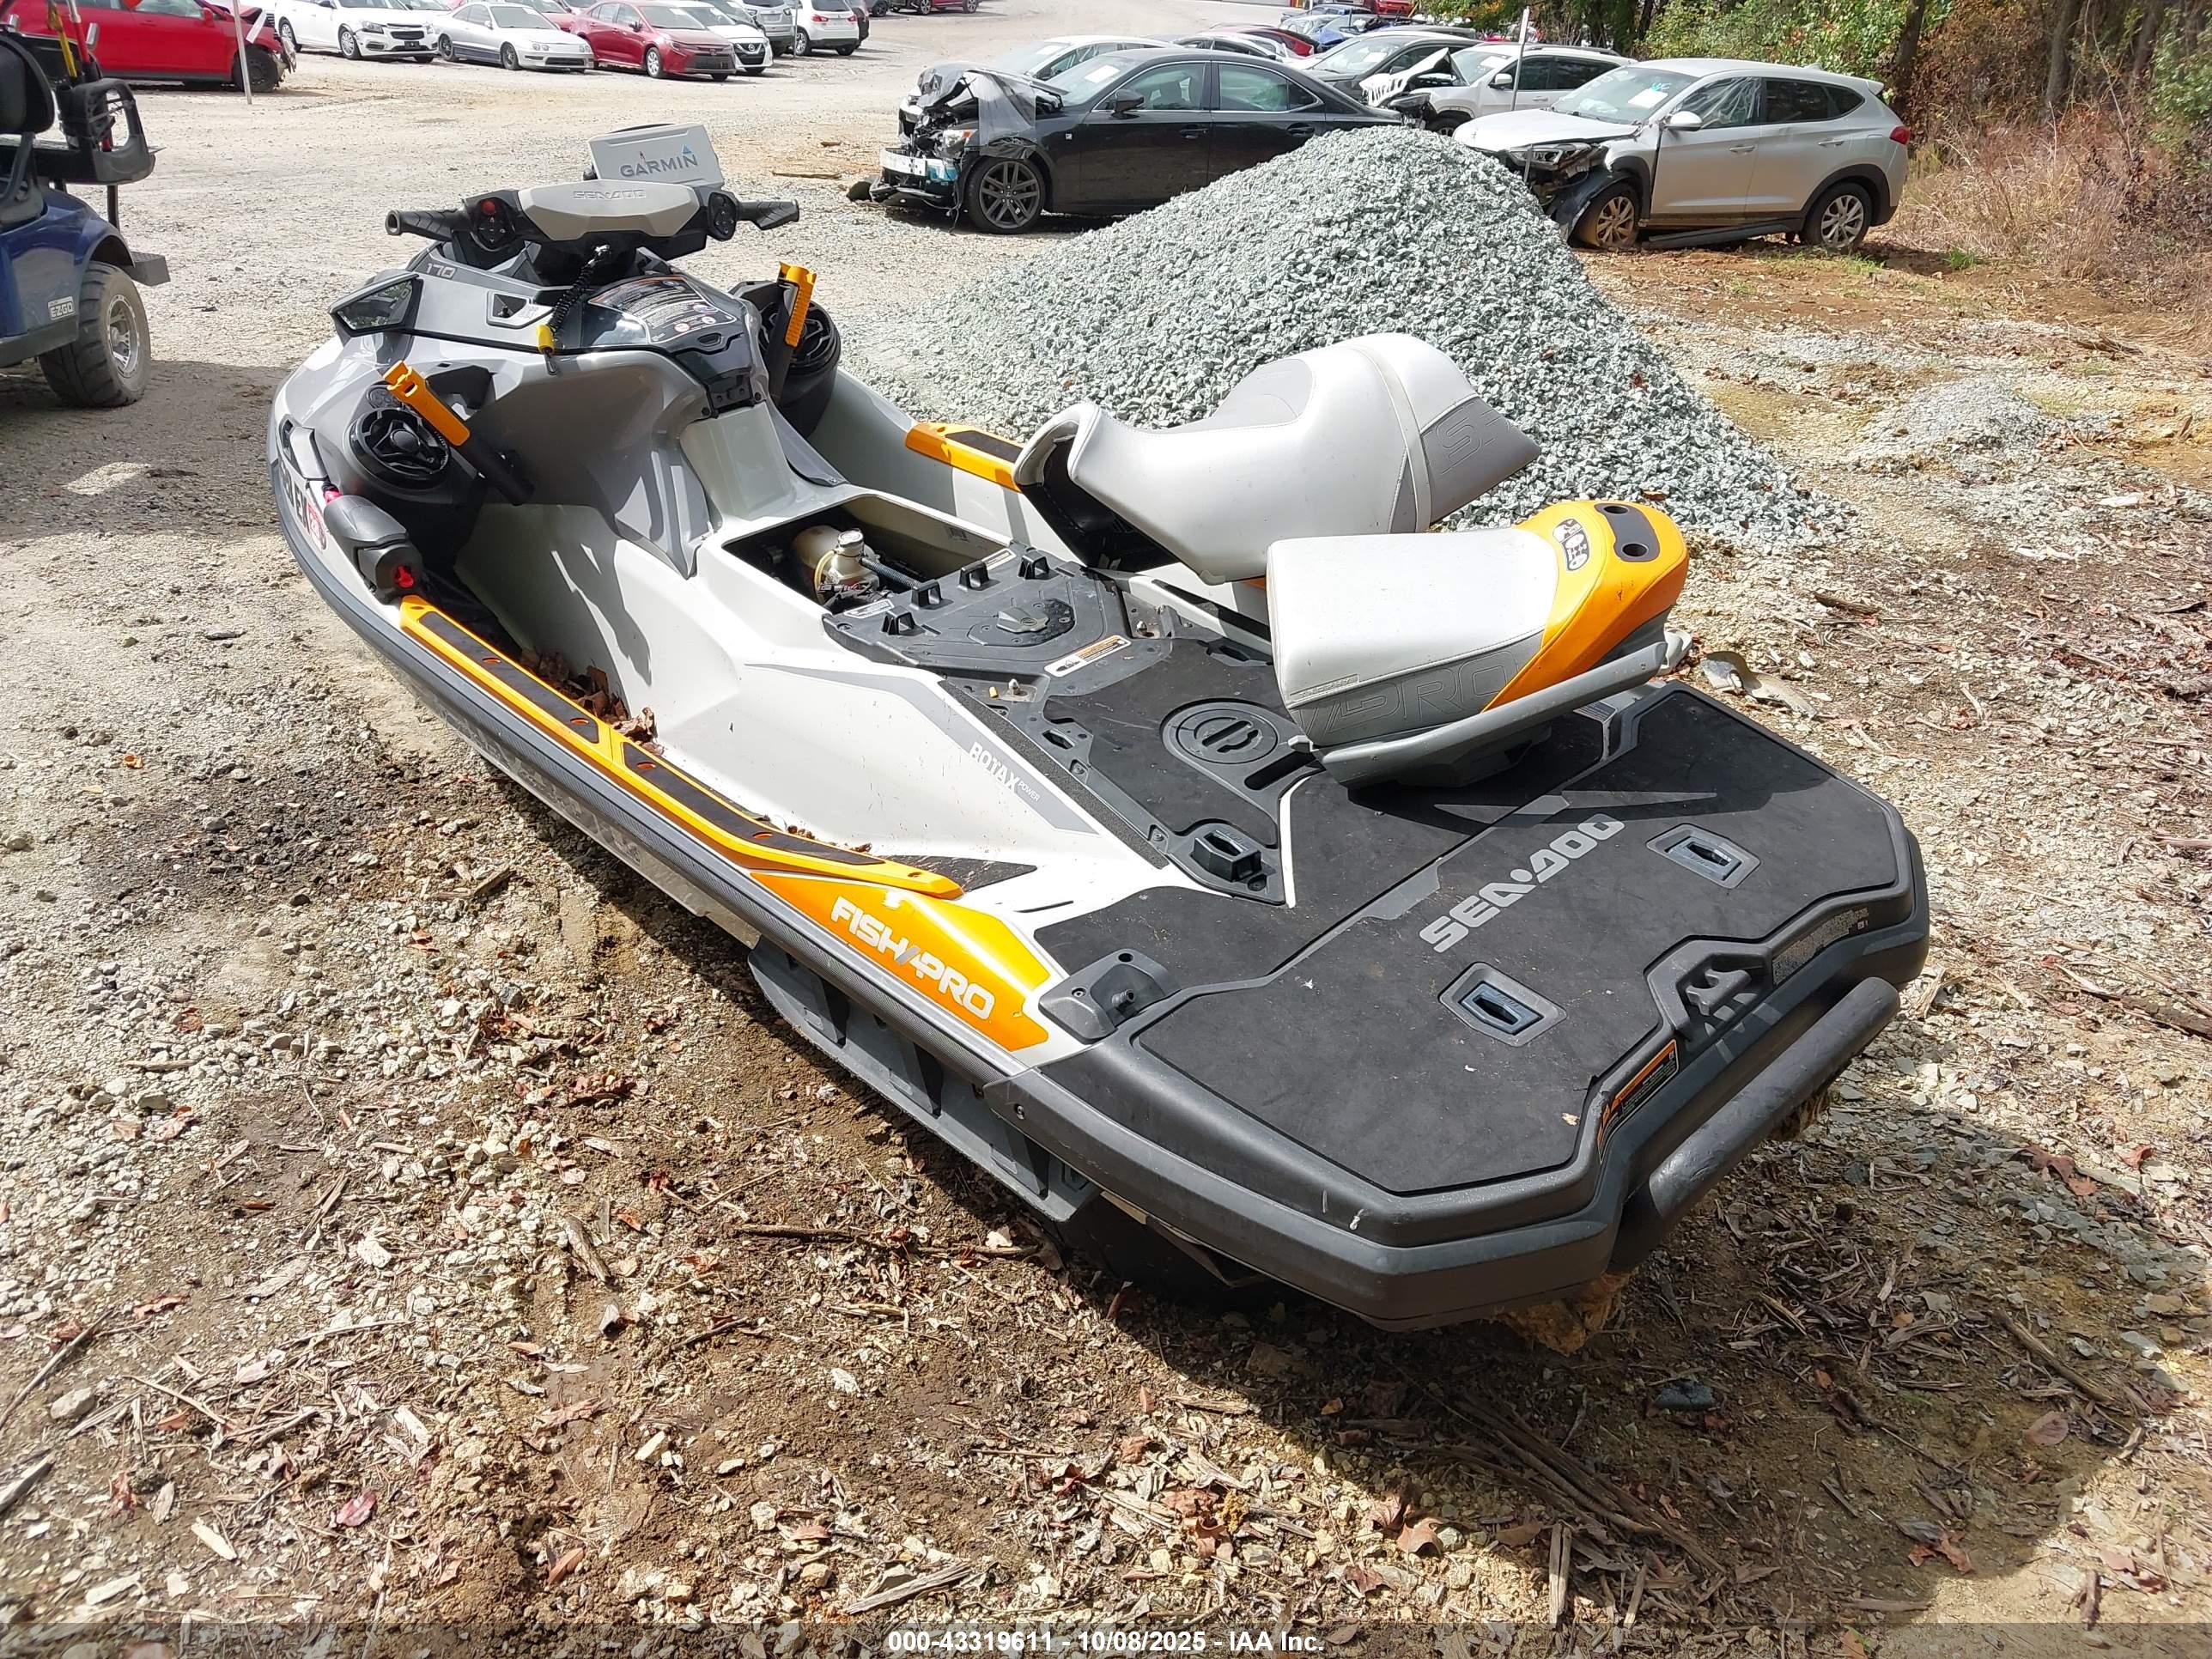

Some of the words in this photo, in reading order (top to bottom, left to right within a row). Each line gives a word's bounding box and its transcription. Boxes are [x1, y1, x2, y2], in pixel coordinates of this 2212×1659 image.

[619, 154, 699, 178] GARMIN
[426, 263, 456, 279] 170
[1018, 780, 1041, 802] POWER
